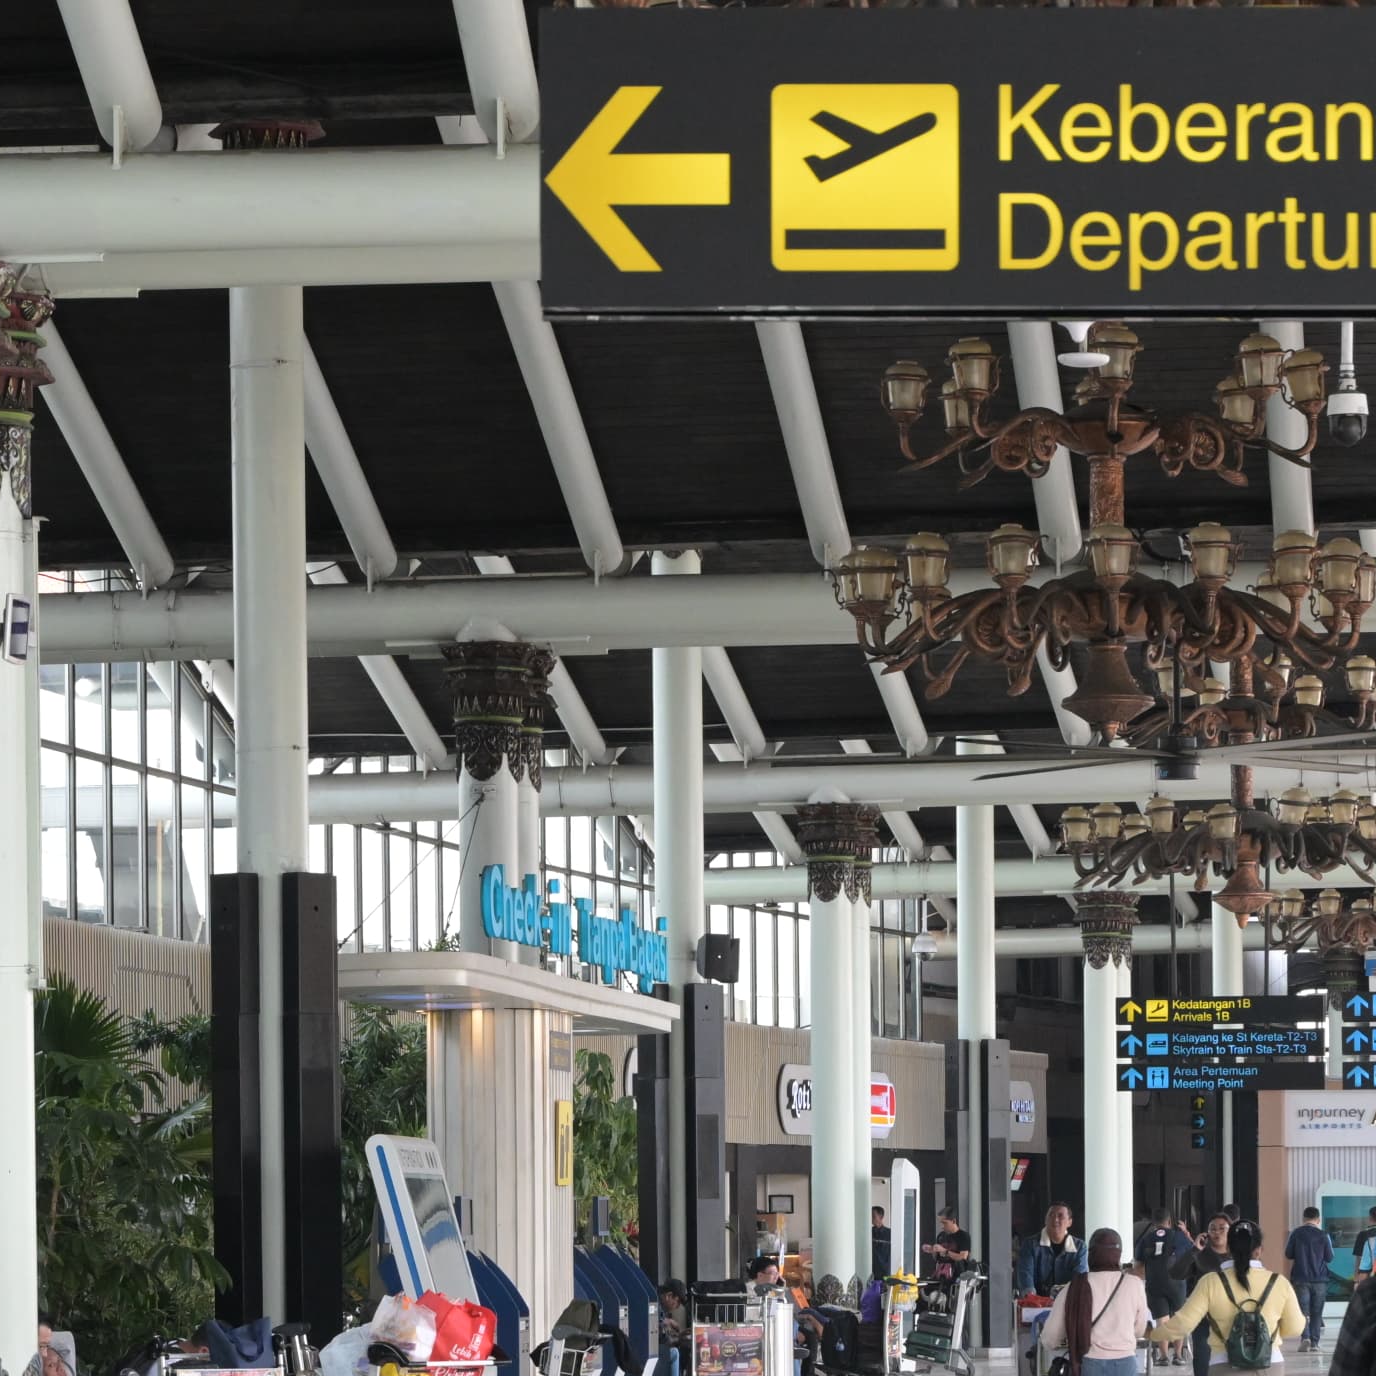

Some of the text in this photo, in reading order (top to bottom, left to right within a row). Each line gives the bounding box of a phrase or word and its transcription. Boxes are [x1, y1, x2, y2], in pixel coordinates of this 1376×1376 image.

[480, 863, 571, 956] Check-in
[620, 904, 669, 994] Bagasi
[1172, 999, 1251, 1010] Kedatangan 1B
[1172, 1011, 1230, 1022] Arrivals 1B
[1172, 1031, 1318, 1045] Kalayang ke St Kereta-T2-T3
[1172, 1044, 1307, 1056] Skytrain to Train Sta-T2-T3
[1173, 1066, 1258, 1076] Area Pertemuan
[1173, 1078, 1244, 1090] Meeting Point
[1297, 1106, 1366, 1121] injourney
